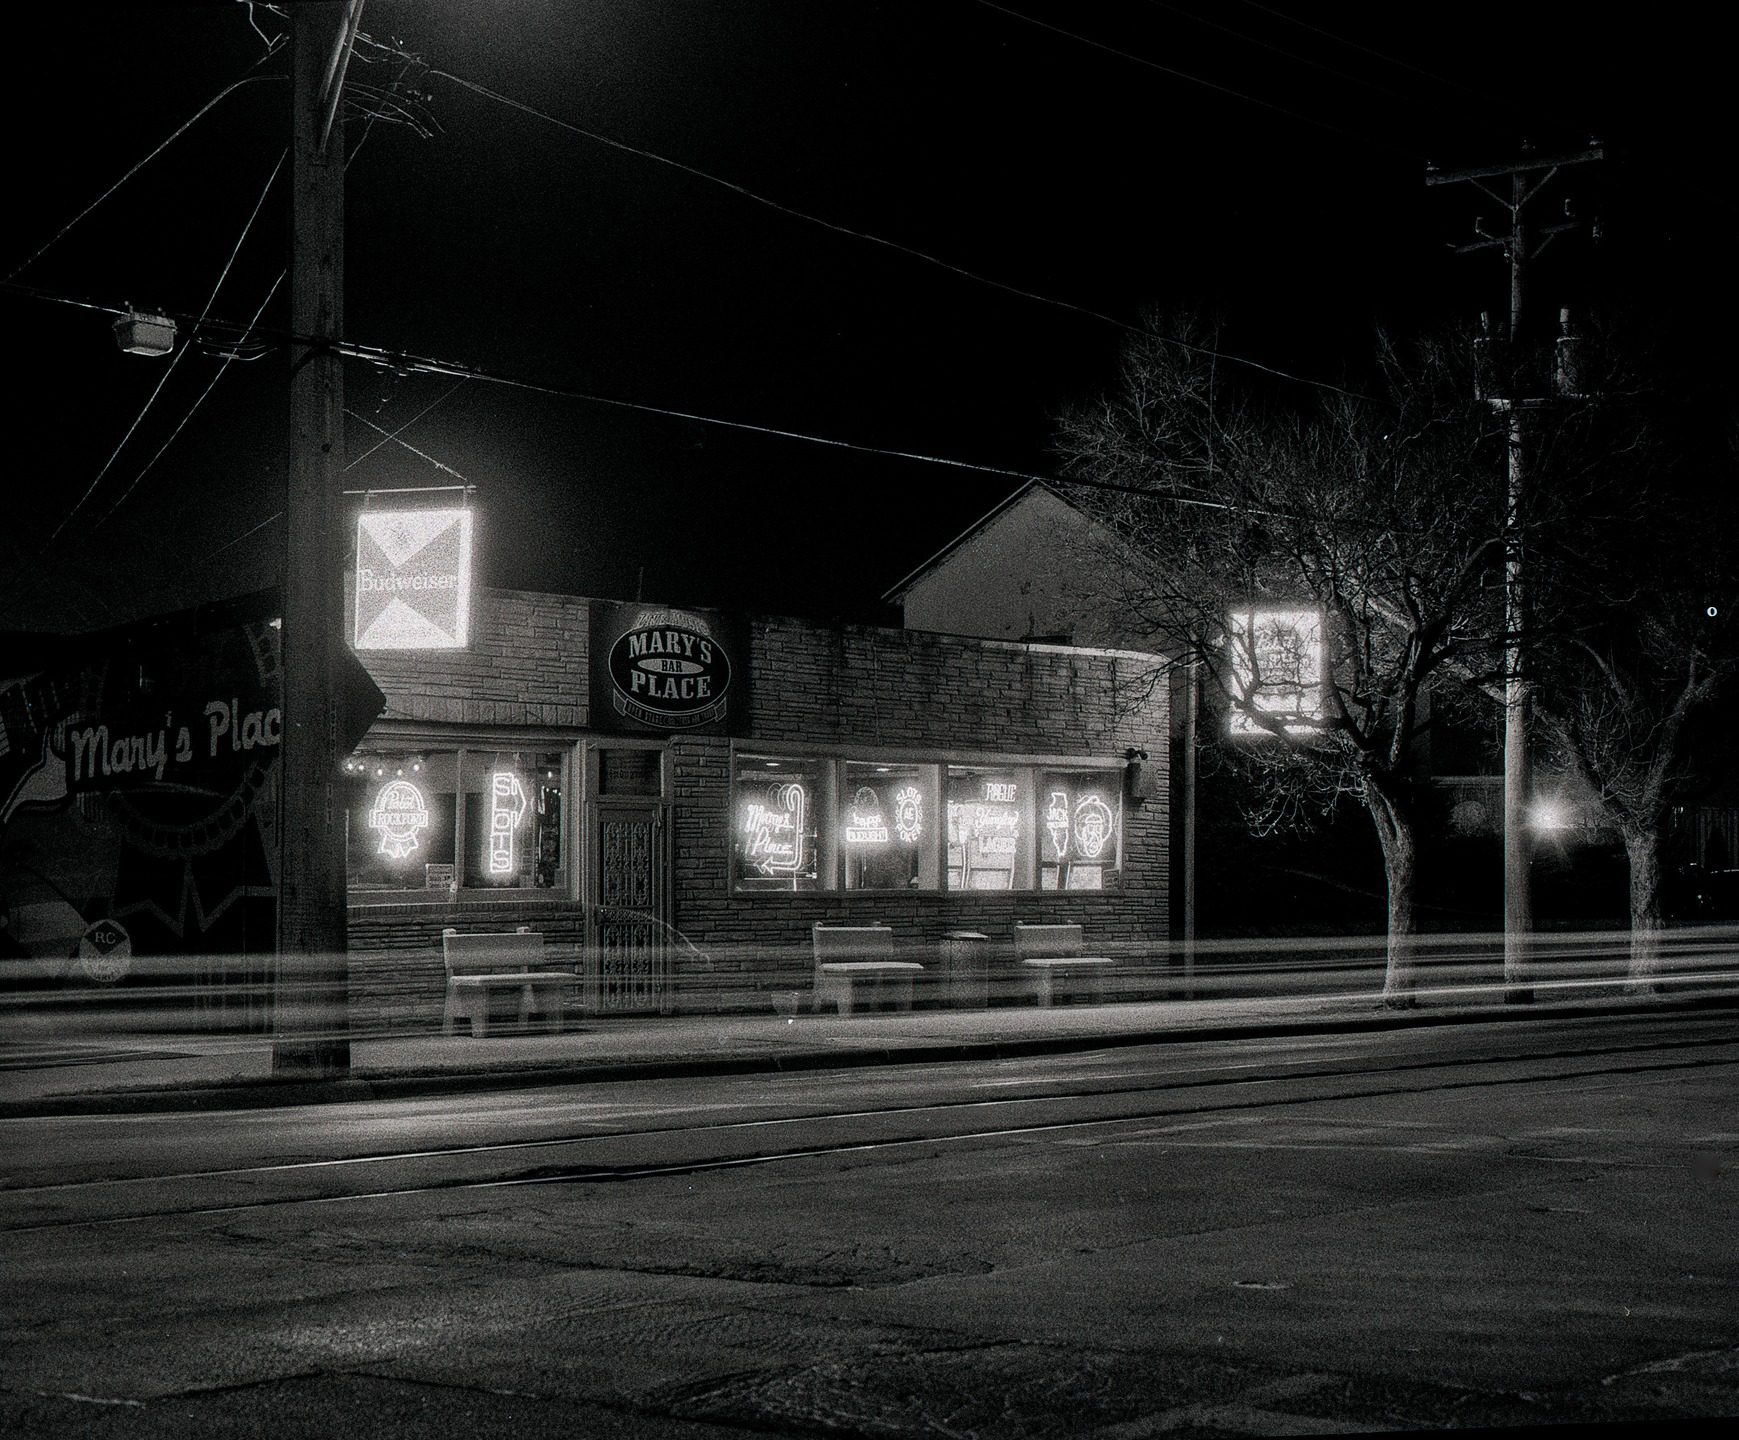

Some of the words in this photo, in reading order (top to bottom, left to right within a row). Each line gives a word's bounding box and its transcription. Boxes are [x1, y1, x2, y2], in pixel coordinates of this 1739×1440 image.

[629, 631, 712, 664] MARY'S
[661, 660, 683, 672] BAR
[630, 670, 712, 699] PLACE
[70, 709, 194, 781] Mary's
[203, 696, 282, 758] Plac
[896, 786, 923, 805] SLOTS
[895, 822, 923, 844] POKER
[95, 931, 116, 945] RC
